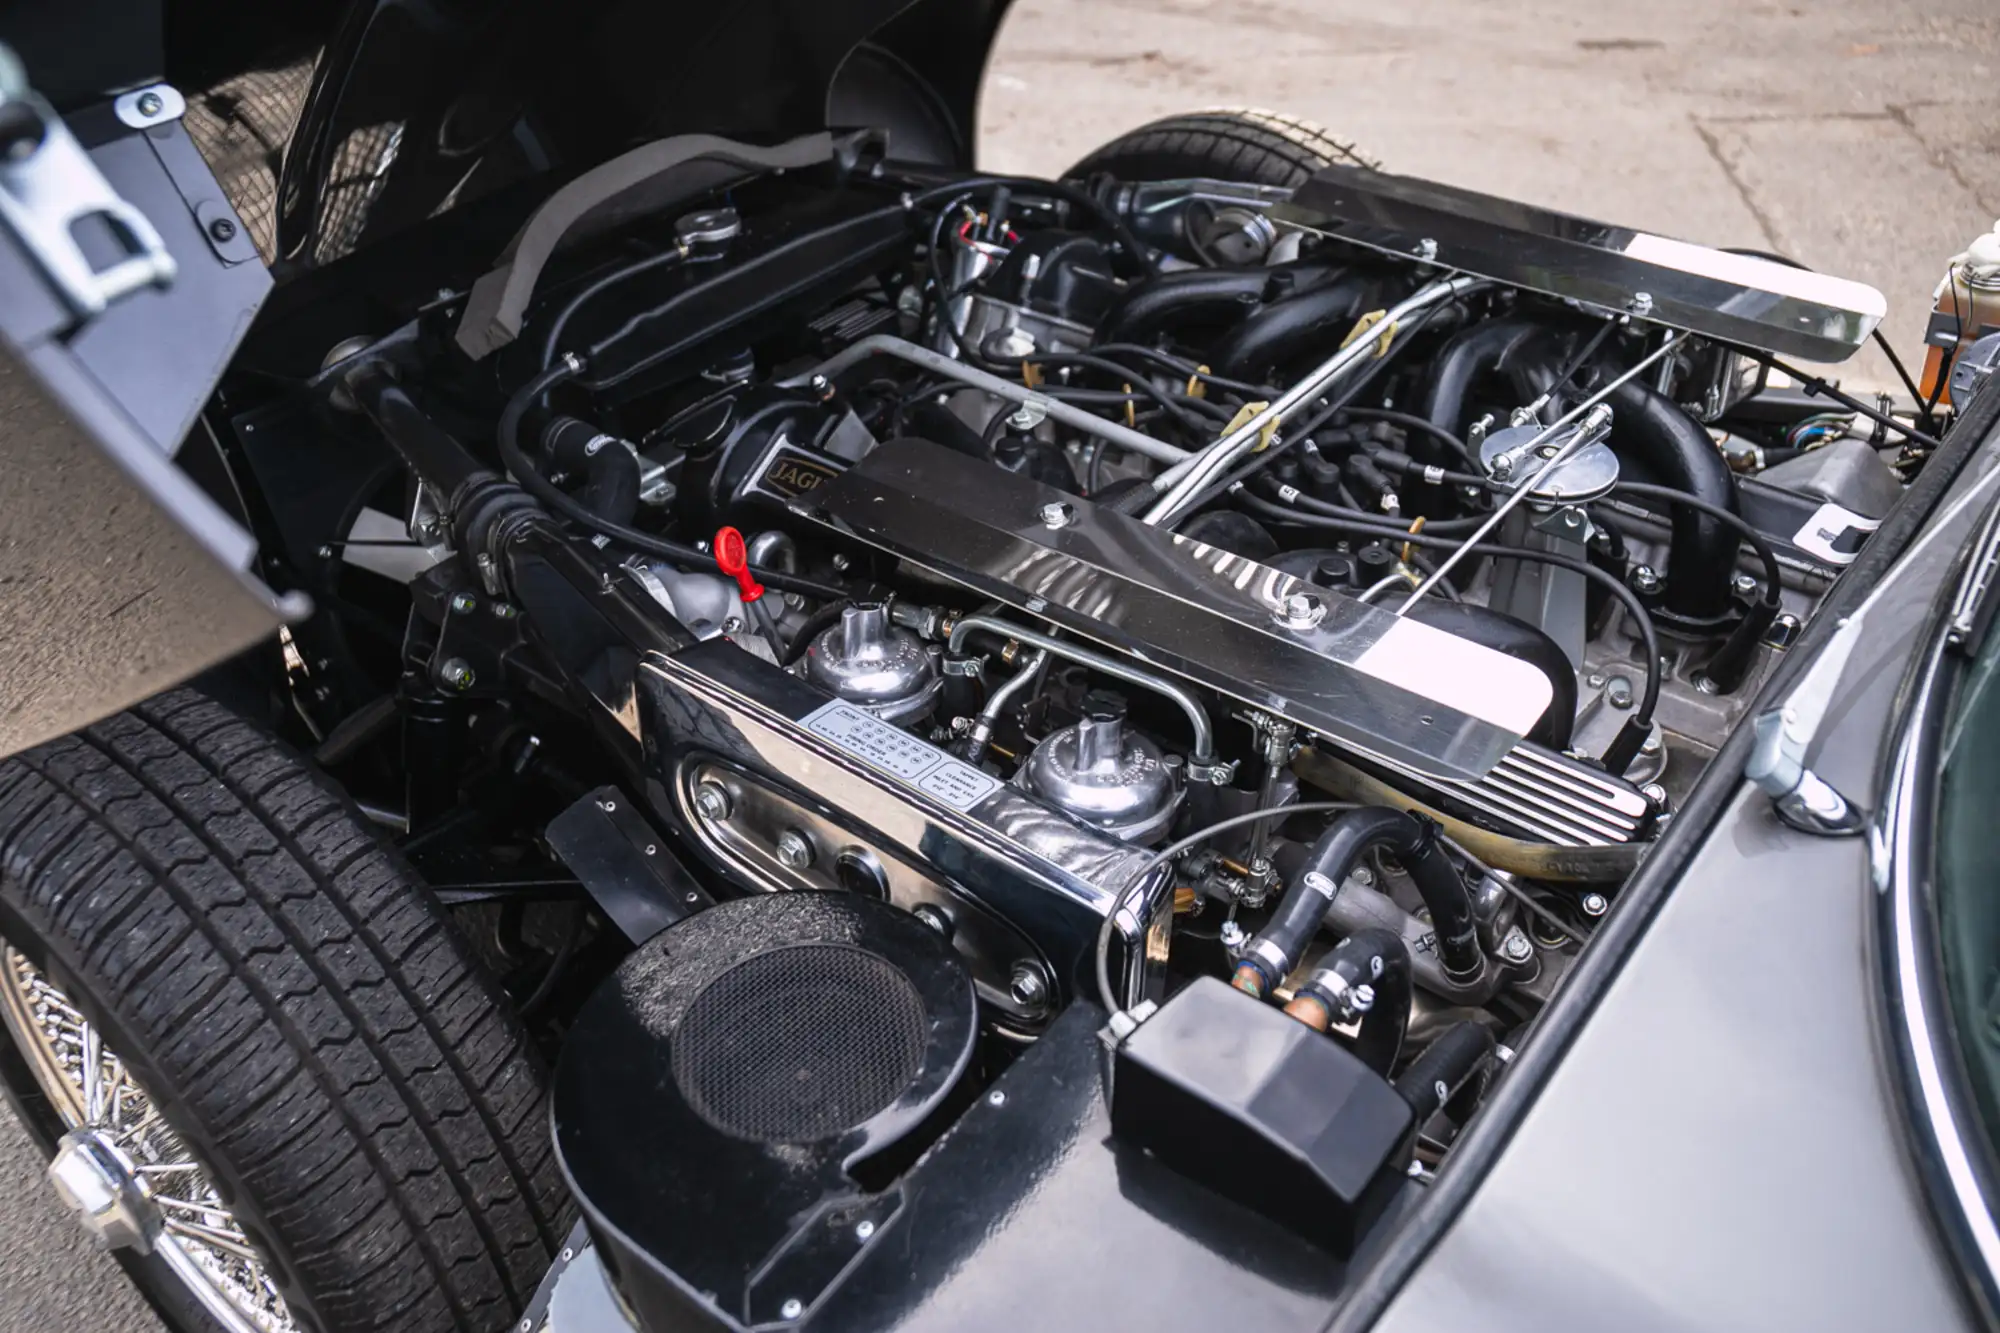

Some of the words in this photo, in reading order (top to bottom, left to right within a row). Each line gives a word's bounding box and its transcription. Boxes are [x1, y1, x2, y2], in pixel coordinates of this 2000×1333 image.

[847, 734, 866, 746] FIRING
[866, 743, 887, 756] ORDER
[945, 772, 978, 791] CLEARANCE
[959, 770, 979, 782] TAPPET
[950, 783, 962, 792] AND
